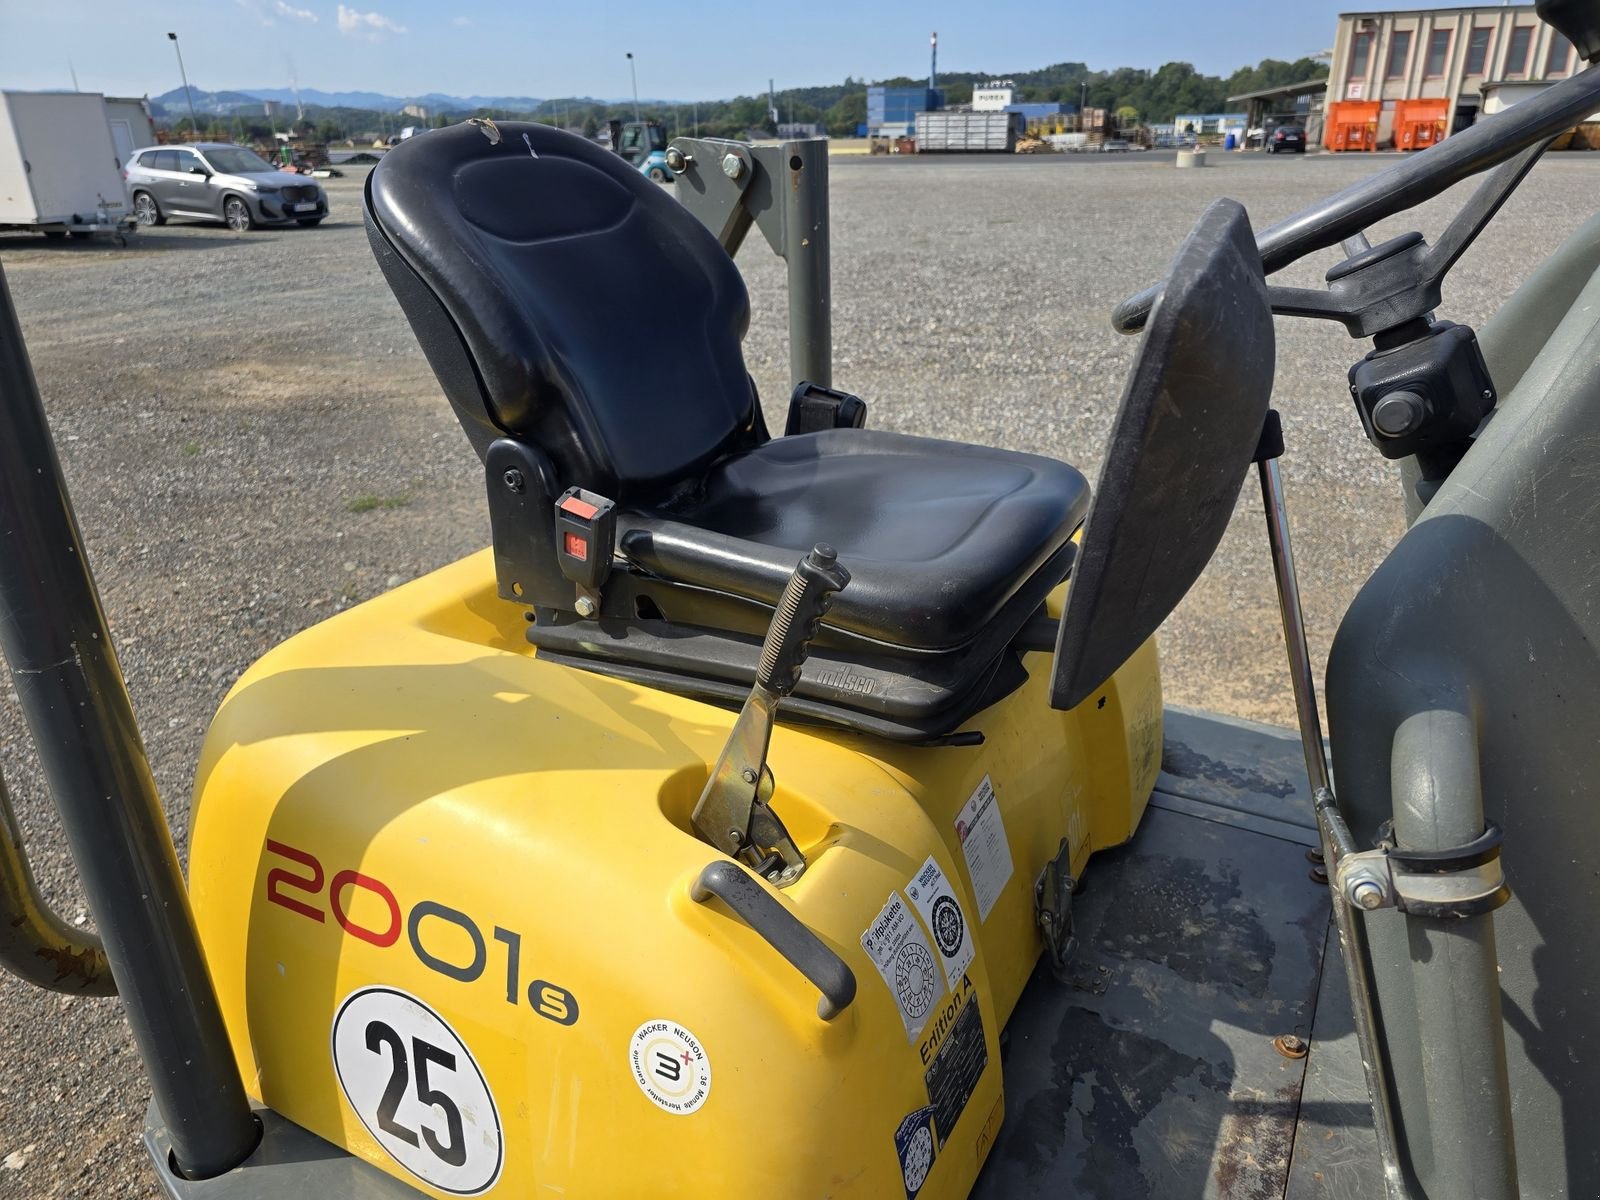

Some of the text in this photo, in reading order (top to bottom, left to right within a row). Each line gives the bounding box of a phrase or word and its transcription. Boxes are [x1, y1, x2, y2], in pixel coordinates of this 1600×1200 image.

[816, 665, 877, 695] milsco
[918, 863, 934, 883] WACKER
[922, 869, 937, 889] NEUSON
[266, 838, 521, 1005] 2001
[866, 901, 902, 950] Püfplakette
[920, 992, 961, 1066] Edition
[963, 974, 972, 996] A
[637, 1023, 703, 1060] WACKER NEUSON
[365, 1020, 467, 1167] 25
[684, 1089, 705, 1109] Monate
